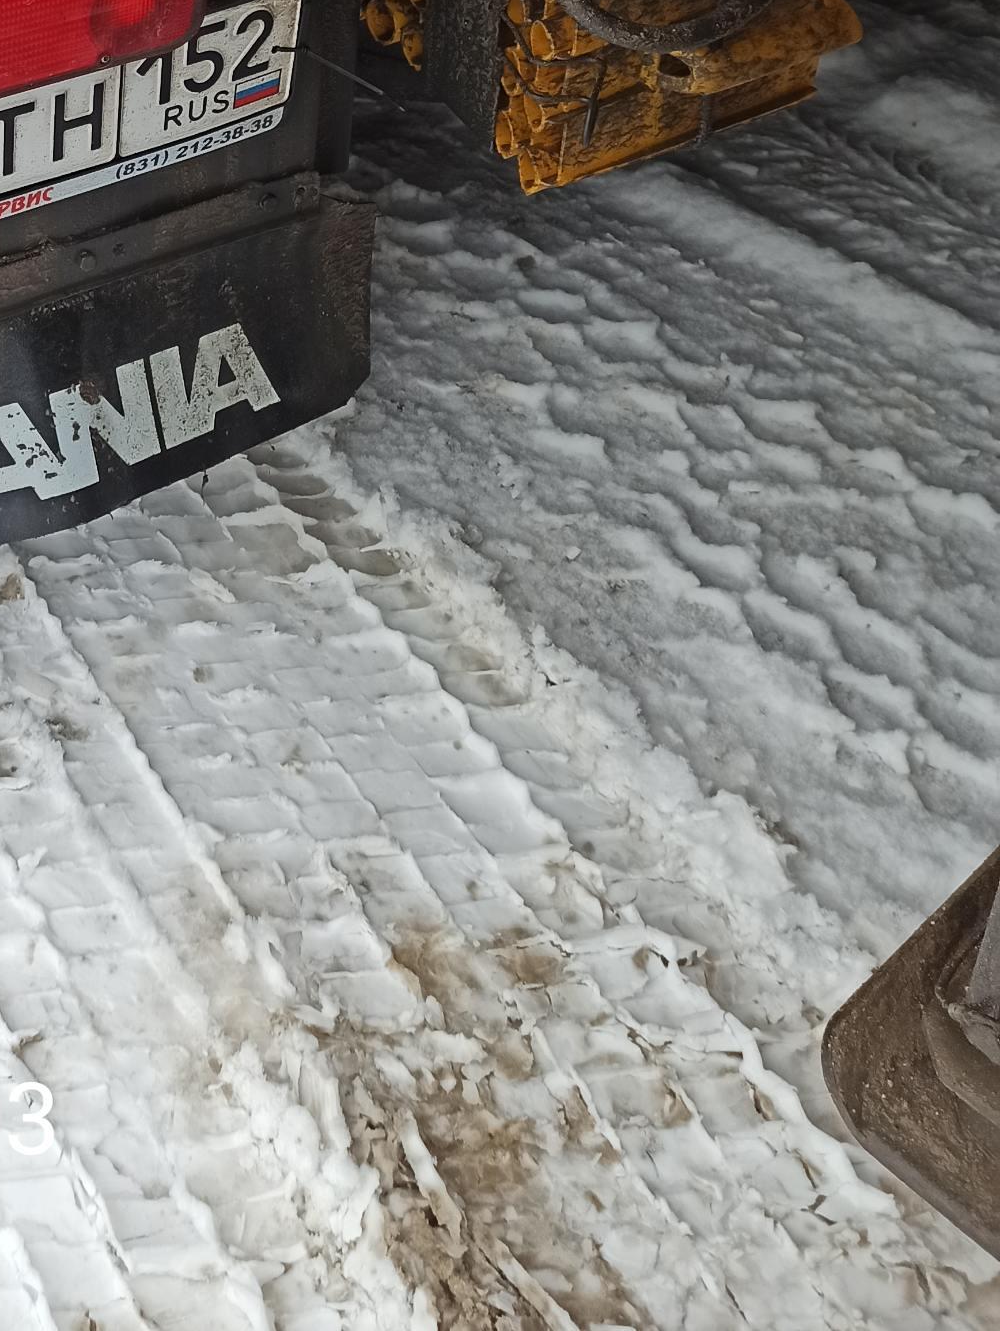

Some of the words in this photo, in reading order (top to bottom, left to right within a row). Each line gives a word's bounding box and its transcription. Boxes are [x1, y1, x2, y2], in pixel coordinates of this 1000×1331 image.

[136, 9, 275, 106] 152
[163, 90, 230, 131] RUS
[115, 150, 169, 180] (831)
[176, 114, 274, 160] 212-38-38
